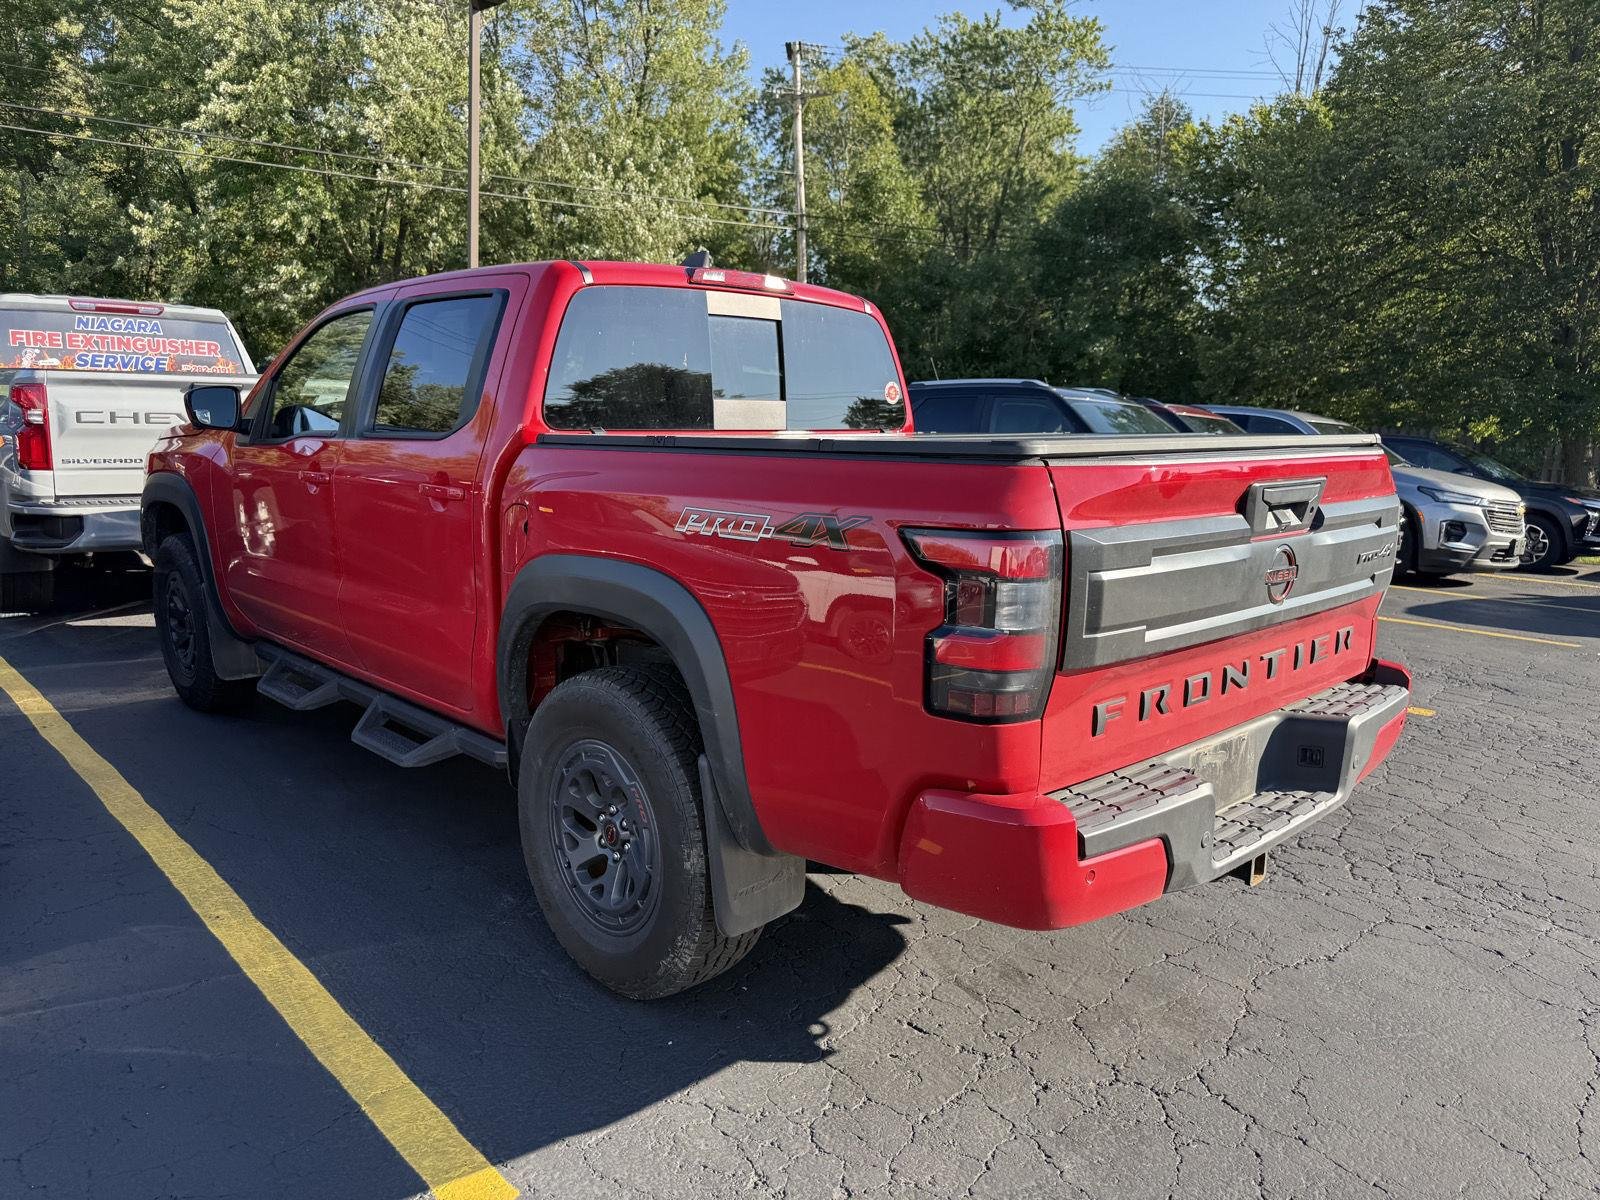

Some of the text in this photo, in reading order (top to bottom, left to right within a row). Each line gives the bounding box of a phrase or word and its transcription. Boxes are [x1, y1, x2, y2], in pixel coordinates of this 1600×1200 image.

[76, 316, 163, 335] NIAGARA
[9, 330, 221, 357] FIRE EXTINGUISHER
[75, 352, 169, 372] SERVICE
[1091, 625, 1354, 737] FRONTIER
